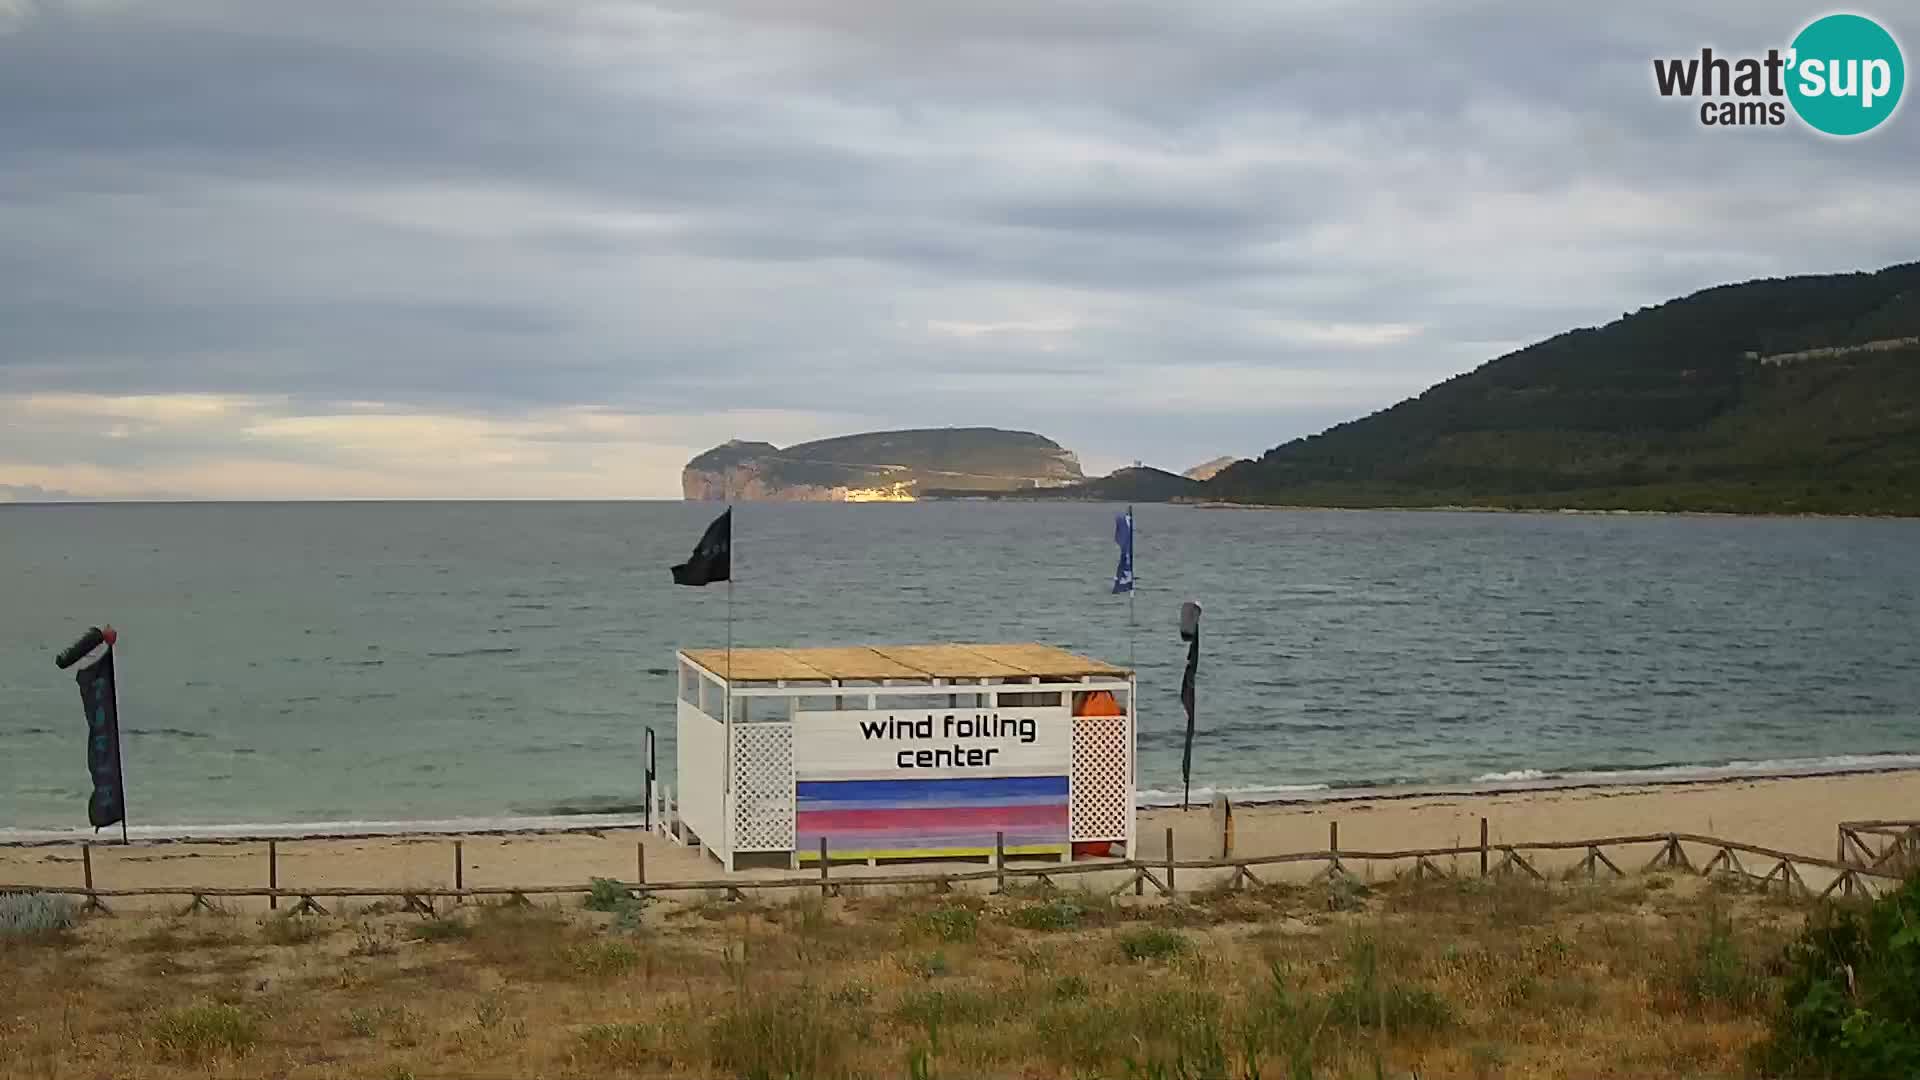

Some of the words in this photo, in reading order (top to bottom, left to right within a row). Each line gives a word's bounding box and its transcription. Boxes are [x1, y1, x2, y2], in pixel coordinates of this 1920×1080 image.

[861, 715, 932, 740] wind
[943, 714, 1036, 743] foiling
[897, 744, 999, 768] center
